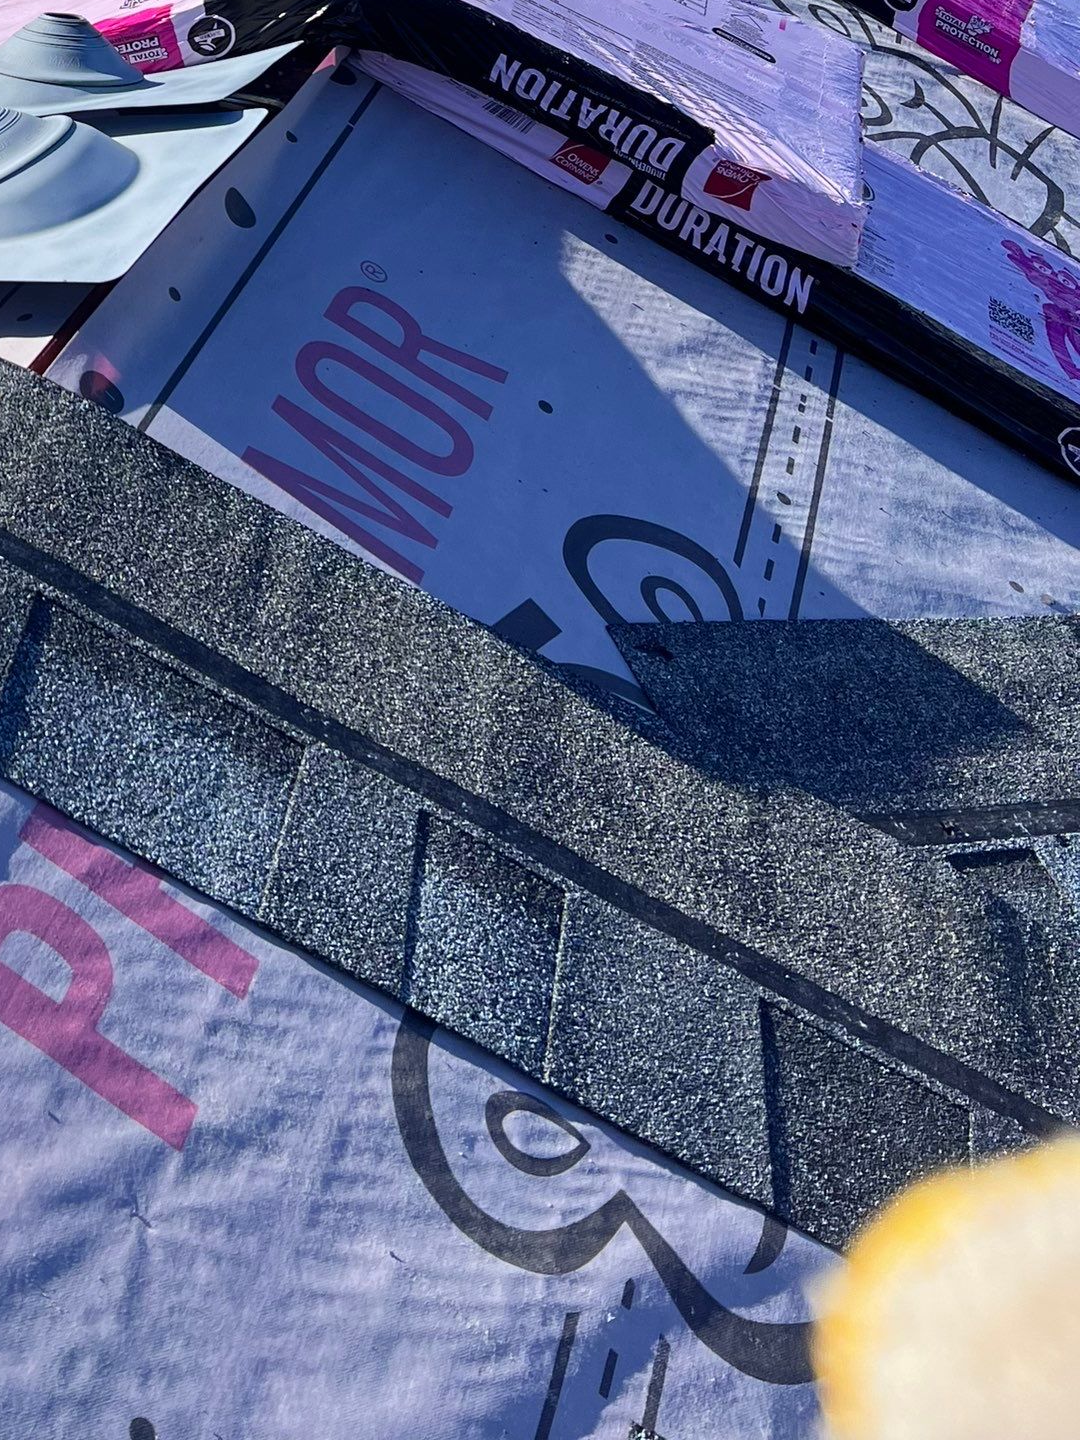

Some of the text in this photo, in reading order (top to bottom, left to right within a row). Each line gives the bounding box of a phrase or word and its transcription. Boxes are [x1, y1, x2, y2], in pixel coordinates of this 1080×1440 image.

[935, 19, 1000, 59] PROTECTION
[133, 49, 161, 62] TOTAL
[489, 53, 686, 172] DURATION
[555, 155, 595, 182] CORNING
[567, 153, 600, 177] OWENS
[717, 167, 750, 184] OWENS
[630, 179, 814, 315] DURATION
